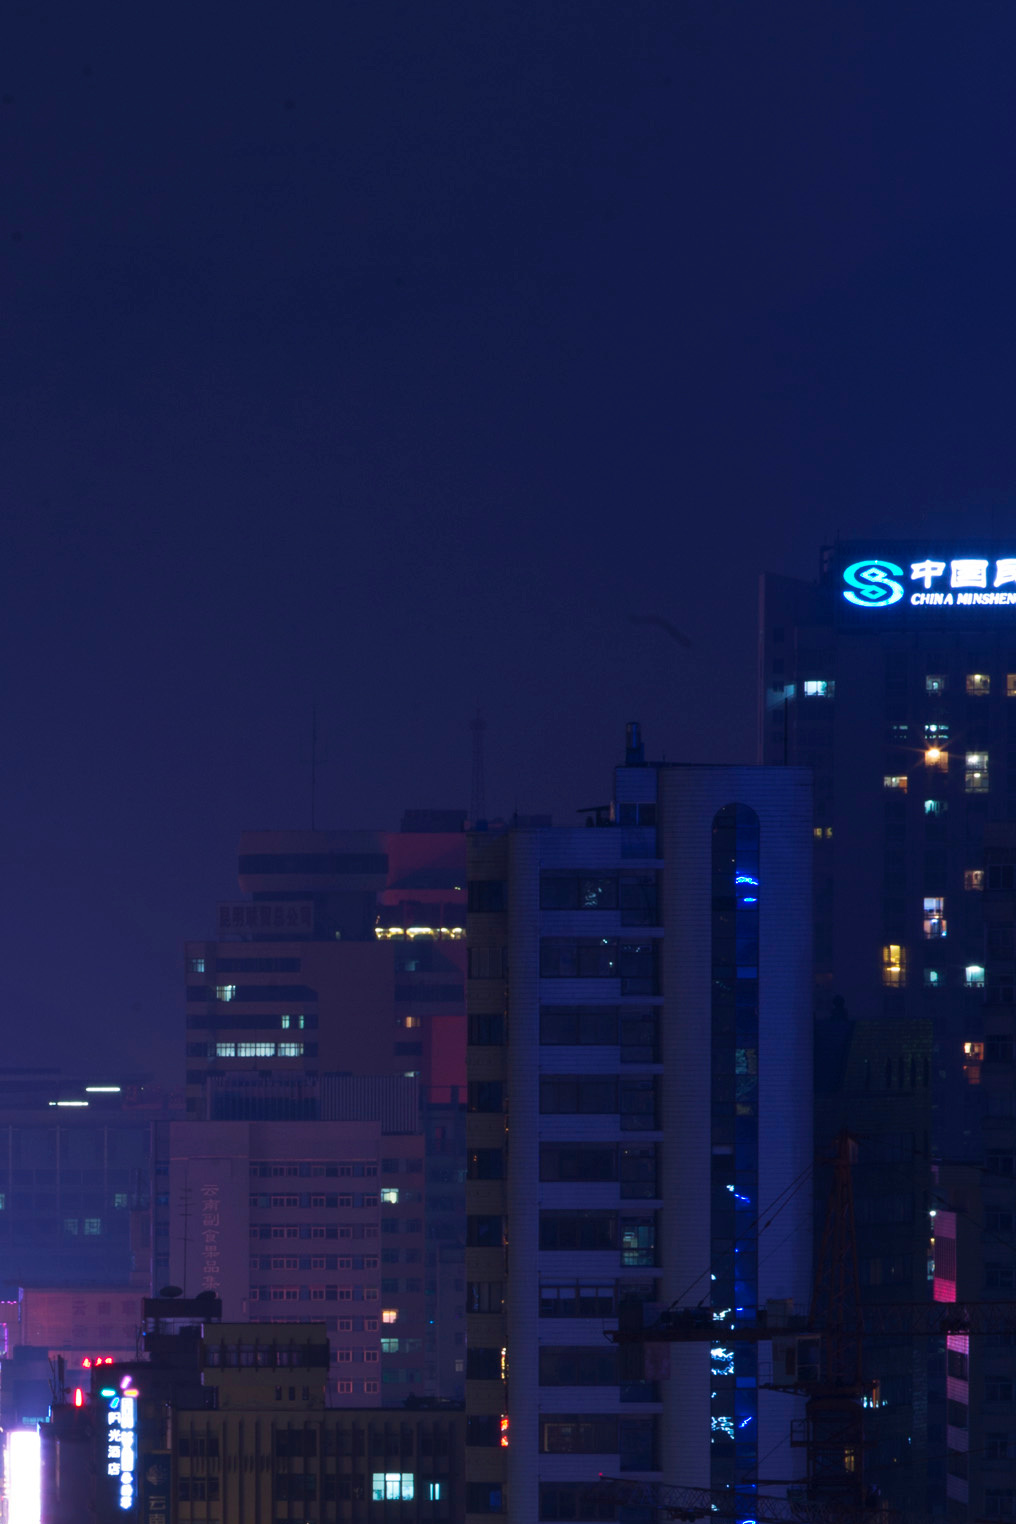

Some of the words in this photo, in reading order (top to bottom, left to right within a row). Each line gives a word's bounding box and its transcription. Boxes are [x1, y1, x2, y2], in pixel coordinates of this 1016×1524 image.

[910, 592, 954, 606] CHINA
[200, 1183, 221, 1300] 云南副食果品集
